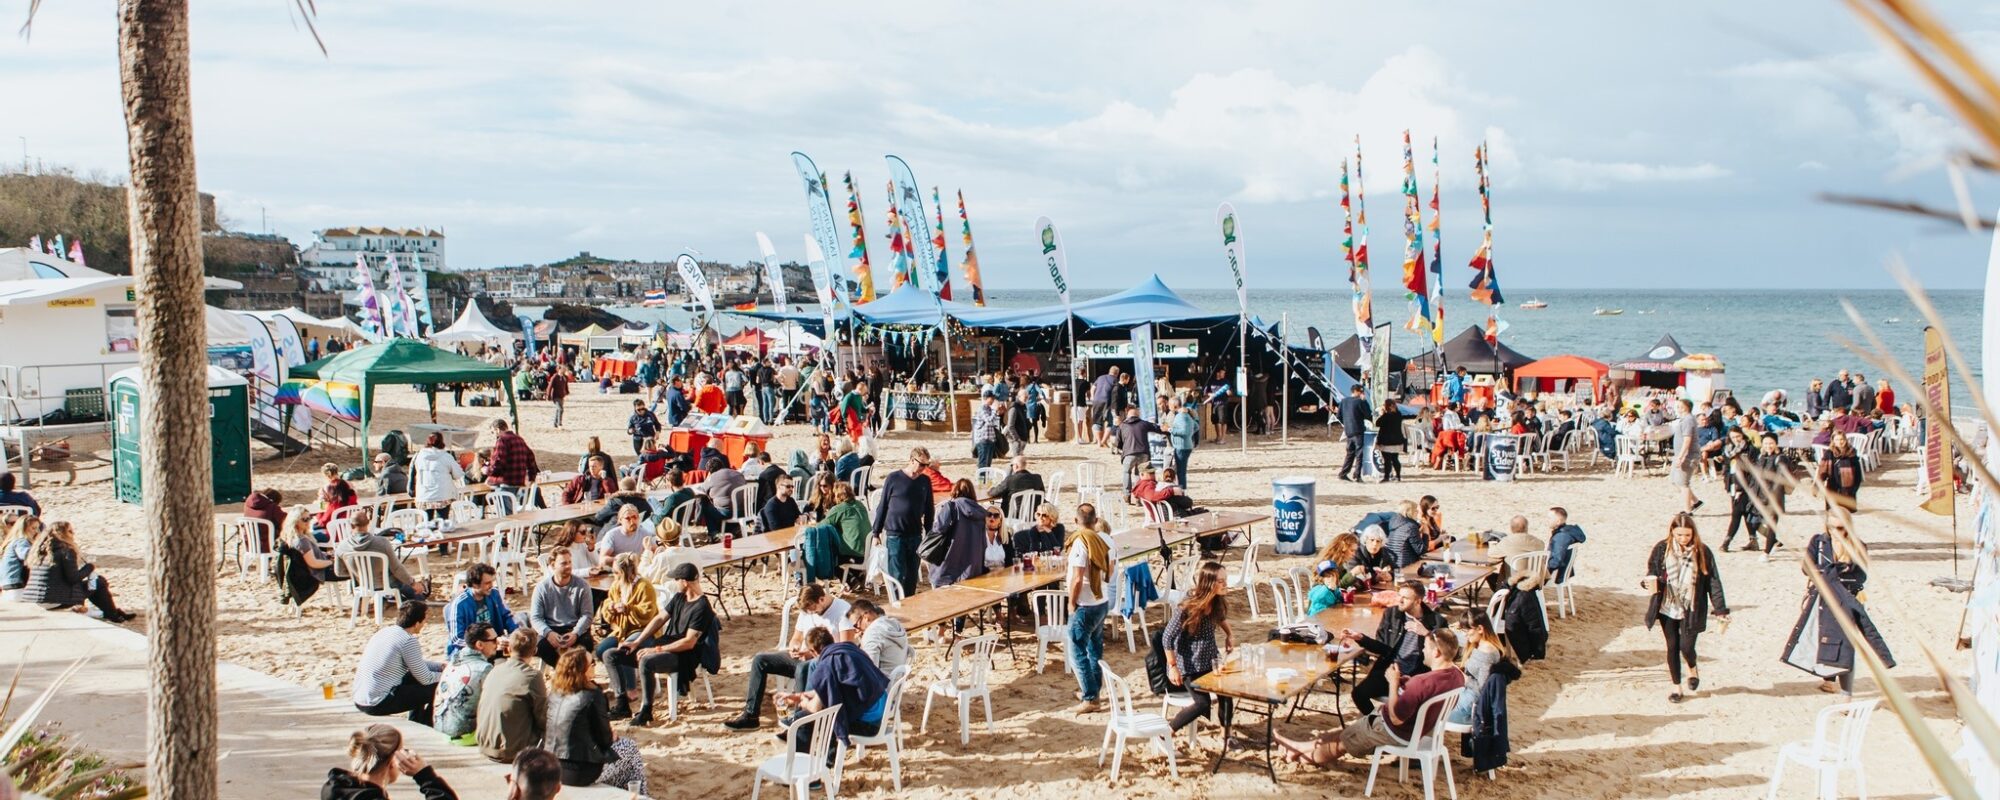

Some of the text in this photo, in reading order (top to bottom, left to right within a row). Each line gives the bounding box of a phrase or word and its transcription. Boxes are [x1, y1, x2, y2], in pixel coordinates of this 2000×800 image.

[1047, 256, 1067, 295] CIDER
[1228, 248, 1243, 291] CIDER
[1093, 342, 1176, 355] Cider Bar
[896, 408, 937, 421] DRY GIN
[1494, 457, 1514, 466] Cider
[1281, 508, 1304, 520] Ives
[1275, 518, 1300, 531] Cider
